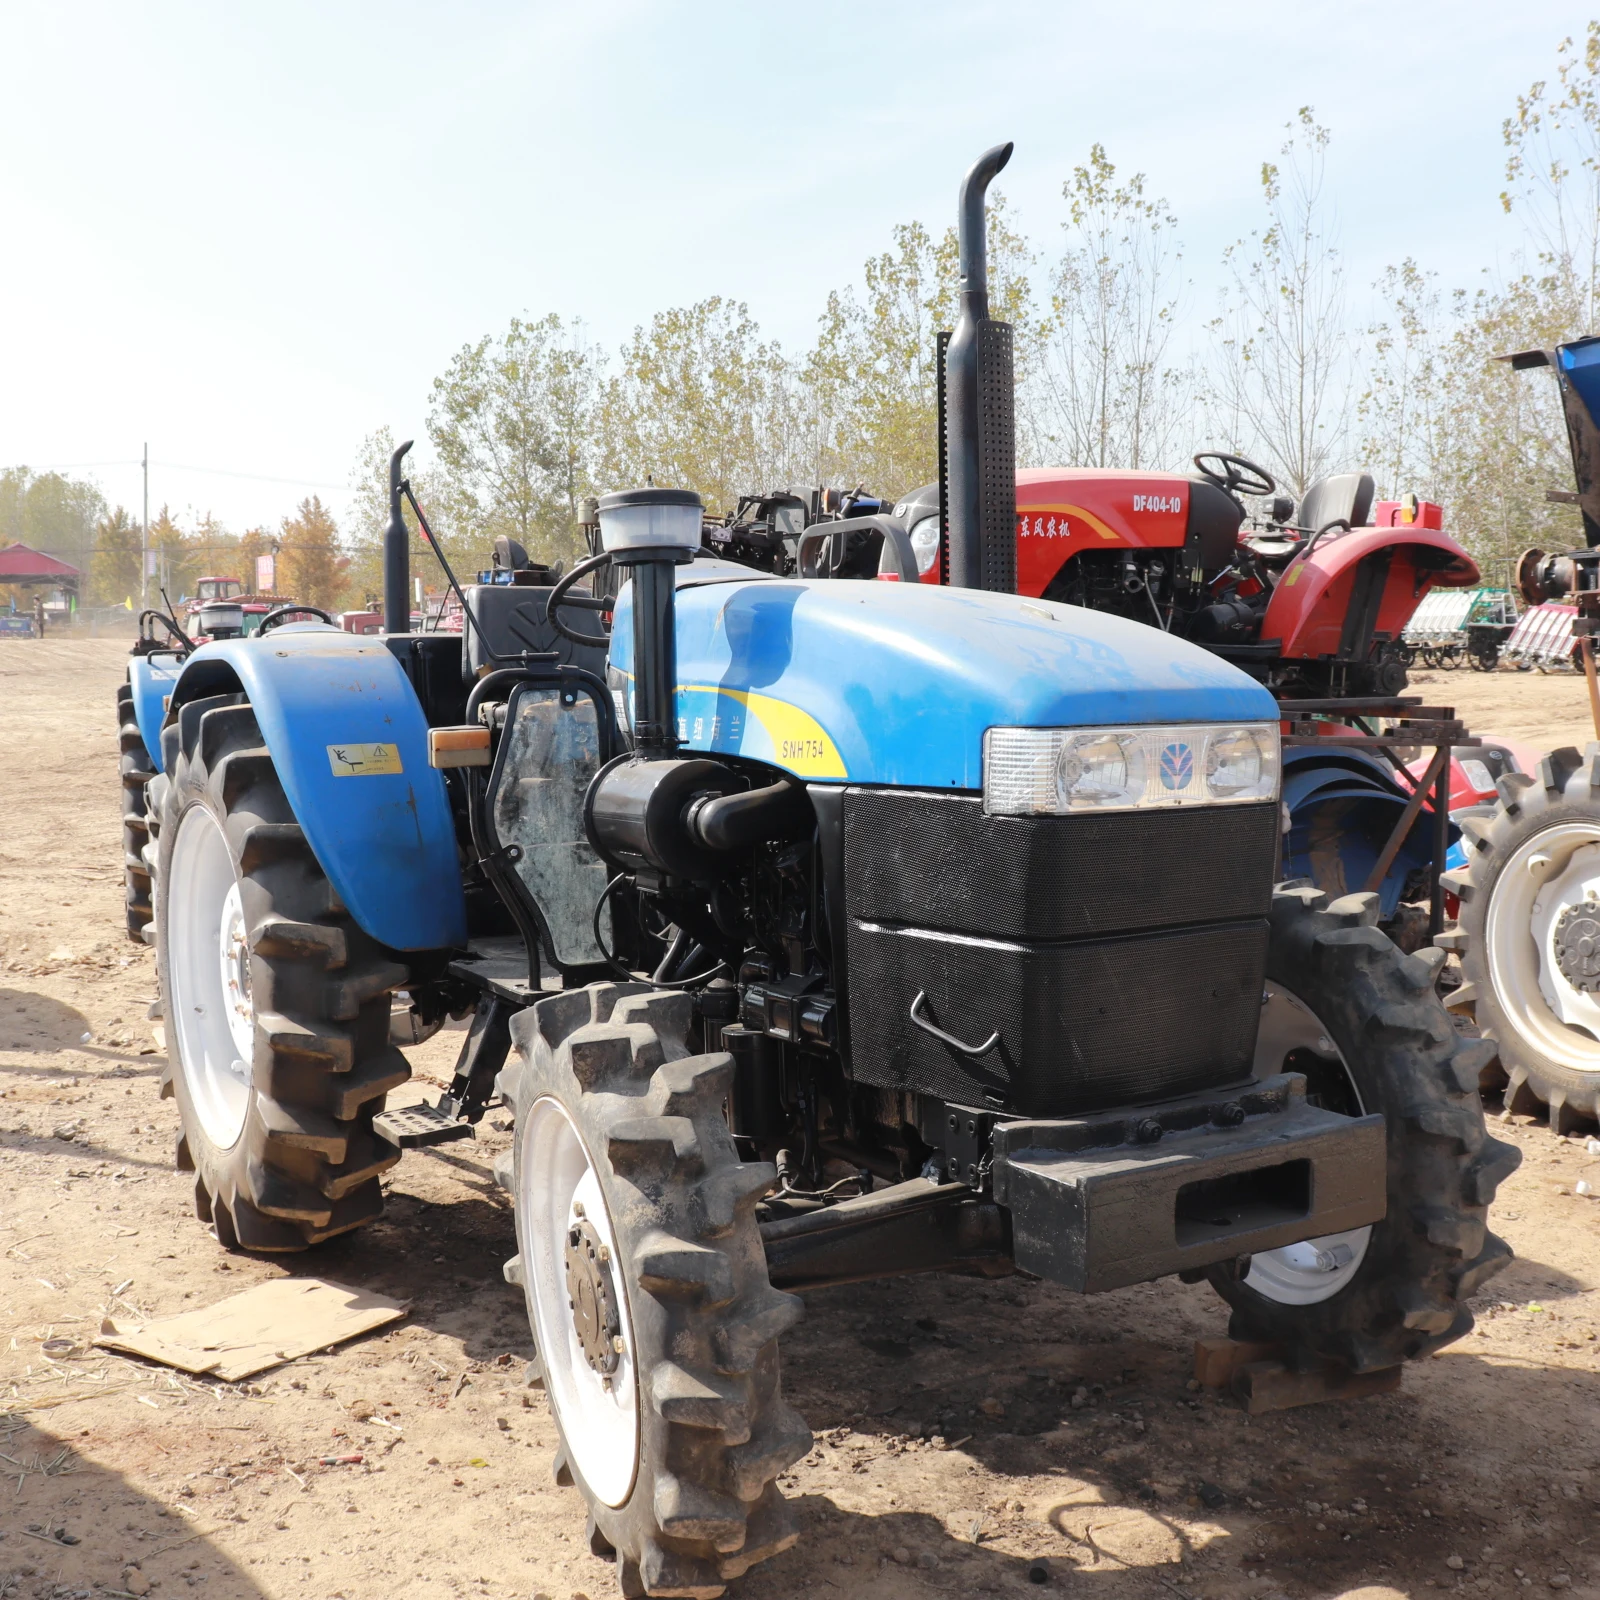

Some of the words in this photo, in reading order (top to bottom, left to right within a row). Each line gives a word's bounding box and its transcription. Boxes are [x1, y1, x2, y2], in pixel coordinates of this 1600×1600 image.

[1133, 495, 1181, 513] DF404-10
[1020, 515, 1071, 539] 东风农机
